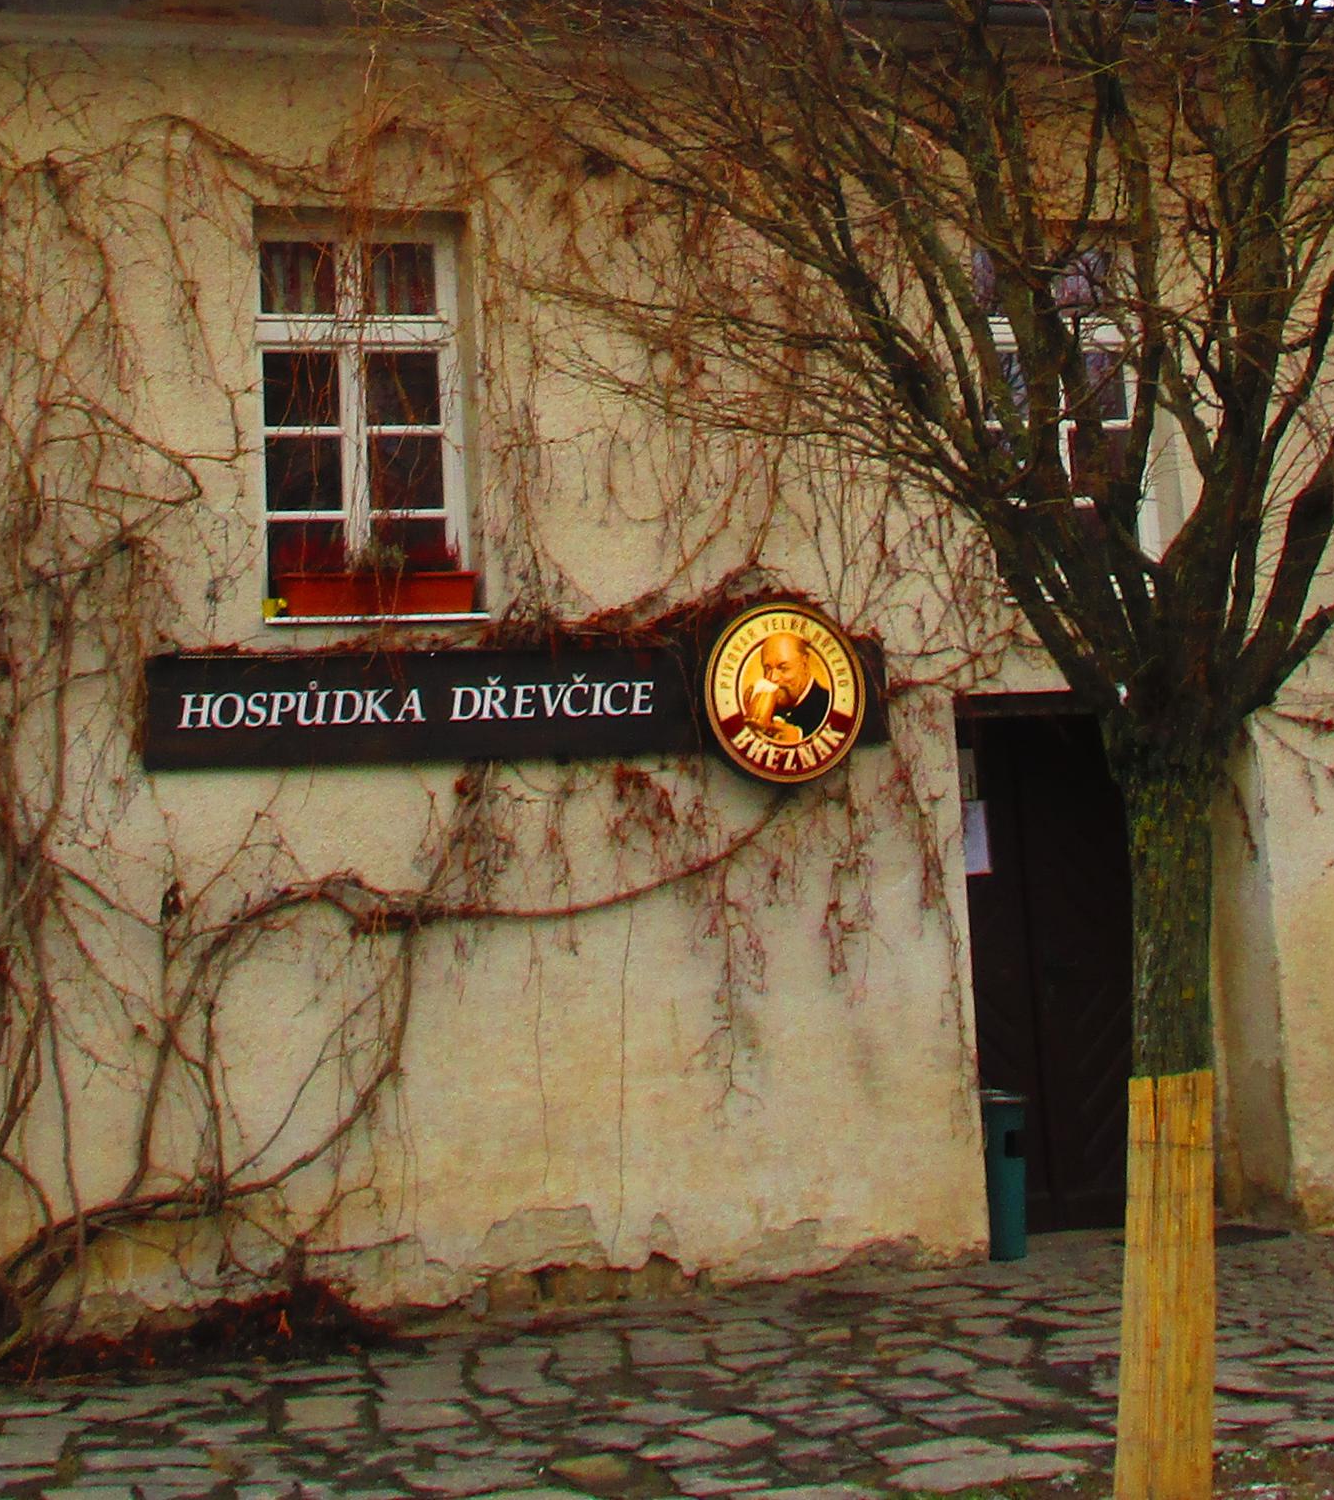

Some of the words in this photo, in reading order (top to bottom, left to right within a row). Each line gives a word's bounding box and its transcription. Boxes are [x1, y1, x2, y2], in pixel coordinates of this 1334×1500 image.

[178, 680, 426, 730] HOSPŮDKA
[449, 673, 655, 722] DŘEVČICE
[731, 722, 846, 772] BŘEZŇÁK
